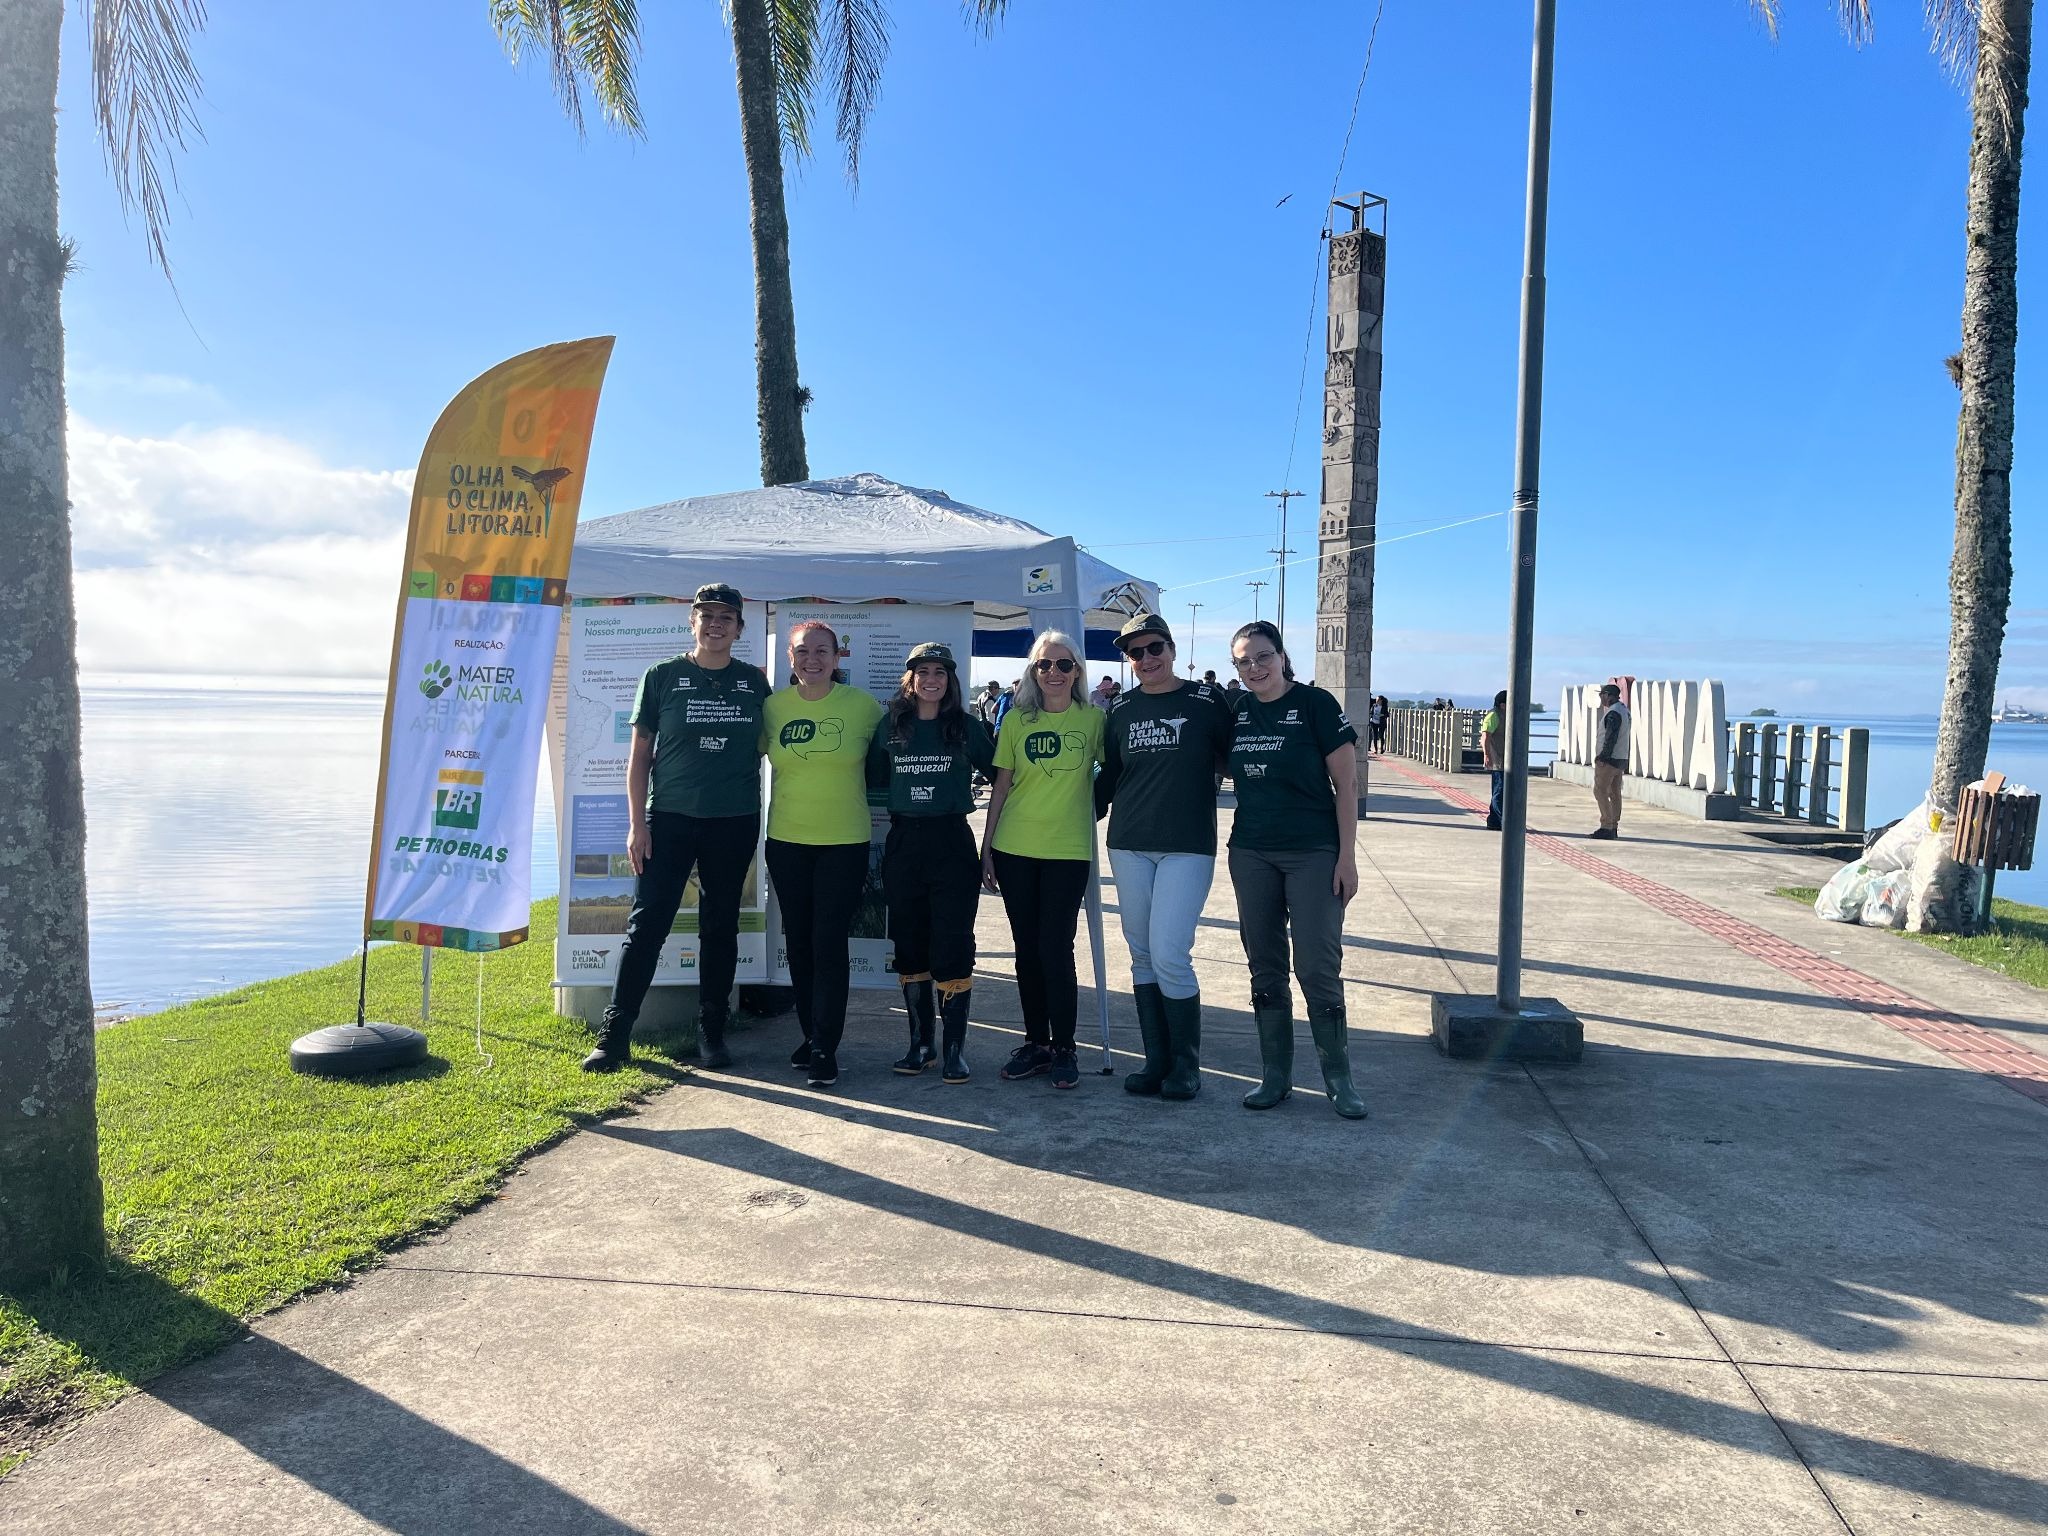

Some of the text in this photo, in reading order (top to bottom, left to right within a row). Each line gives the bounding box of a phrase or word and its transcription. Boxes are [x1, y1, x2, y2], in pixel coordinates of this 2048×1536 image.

[450, 464, 504, 487] OLHA
[447, 488, 533, 513] O CLIMA,
[447, 512, 542, 538] LITORAL!
[585, 617, 621, 628] Exposição
[788, 611, 871, 620] Manguezais ameaçados!
[584, 627, 615, 637] Nossos
[617, 625, 669, 637] manguezais
[677, 625, 692, 634] bre
[458, 665, 515, 684] MATER
[456, 684, 523, 704] NATURA
[686, 716, 718, 724] Educação
[1129, 719, 1155, 732] OLHA
[791, 724, 811, 740] UC
[1558, 677, 1727, 794] ANTNINA
[1037, 736, 1056, 754] UC
[1232, 741, 1283, 752] manguezal!
[894, 755, 918, 763] Resista
[895, 761, 951, 775] manguezal!
[442, 790, 478, 814] BR
[395, 836, 508, 863] PETROBRAS
[849, 957, 868, 965] ATER
[849, 965, 875, 973] ATURA
